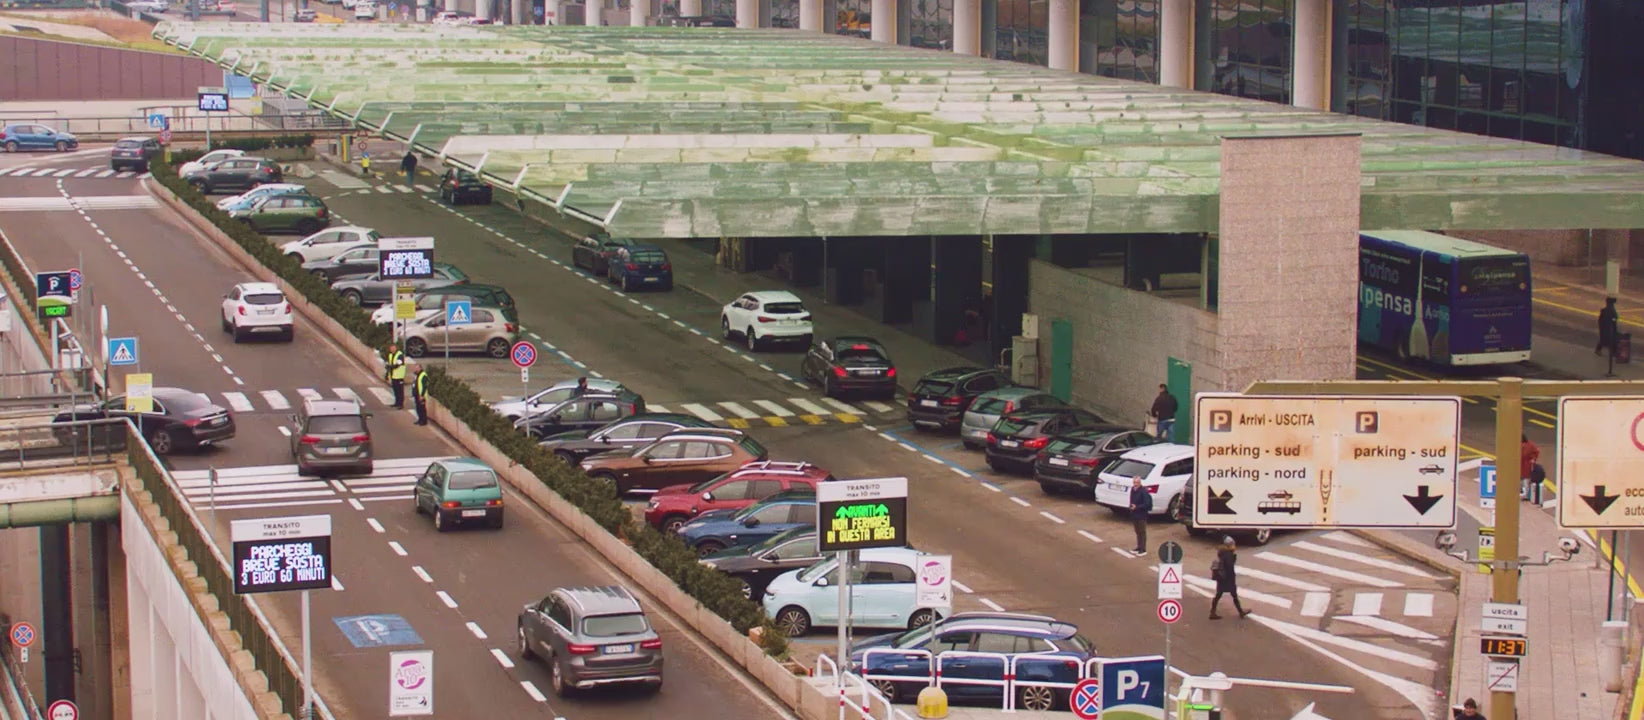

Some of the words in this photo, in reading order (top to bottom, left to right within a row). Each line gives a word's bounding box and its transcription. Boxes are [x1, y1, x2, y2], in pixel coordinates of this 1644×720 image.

[1363, 258, 1400, 284] Torino
[50, 280, 58, 290] P
[1239, 414, 1266, 426] Arrivi
[1276, 414, 1315, 426] USCITA
[1208, 444, 1260, 459] parking
[1275, 445, 1301, 457] sud
[1354, 446, 1406, 460] parking
[1420, 446, 1446, 458] sud
[1207, 467, 1260, 481] parking
[1274, 467, 1306, 479] nord
[852, 516, 890, 530] FERMARSI
[827, 530, 835, 543] IN
[839, 528, 870, 542] QUESTA
[874, 527, 895, 540] AREA
[251, 543, 312, 559] PARCHEGGI
[242, 558, 280, 573] BREVE
[285, 555, 323, 570] SOSTA
[241, 572, 248, 585] 3
[253, 570, 276, 585] EURO
[280, 569, 292, 583] 60
[297, 567, 325, 581] MINUTI
[1164, 606, 1176, 617] 10
[1487, 640, 1525, 655] 11:37
